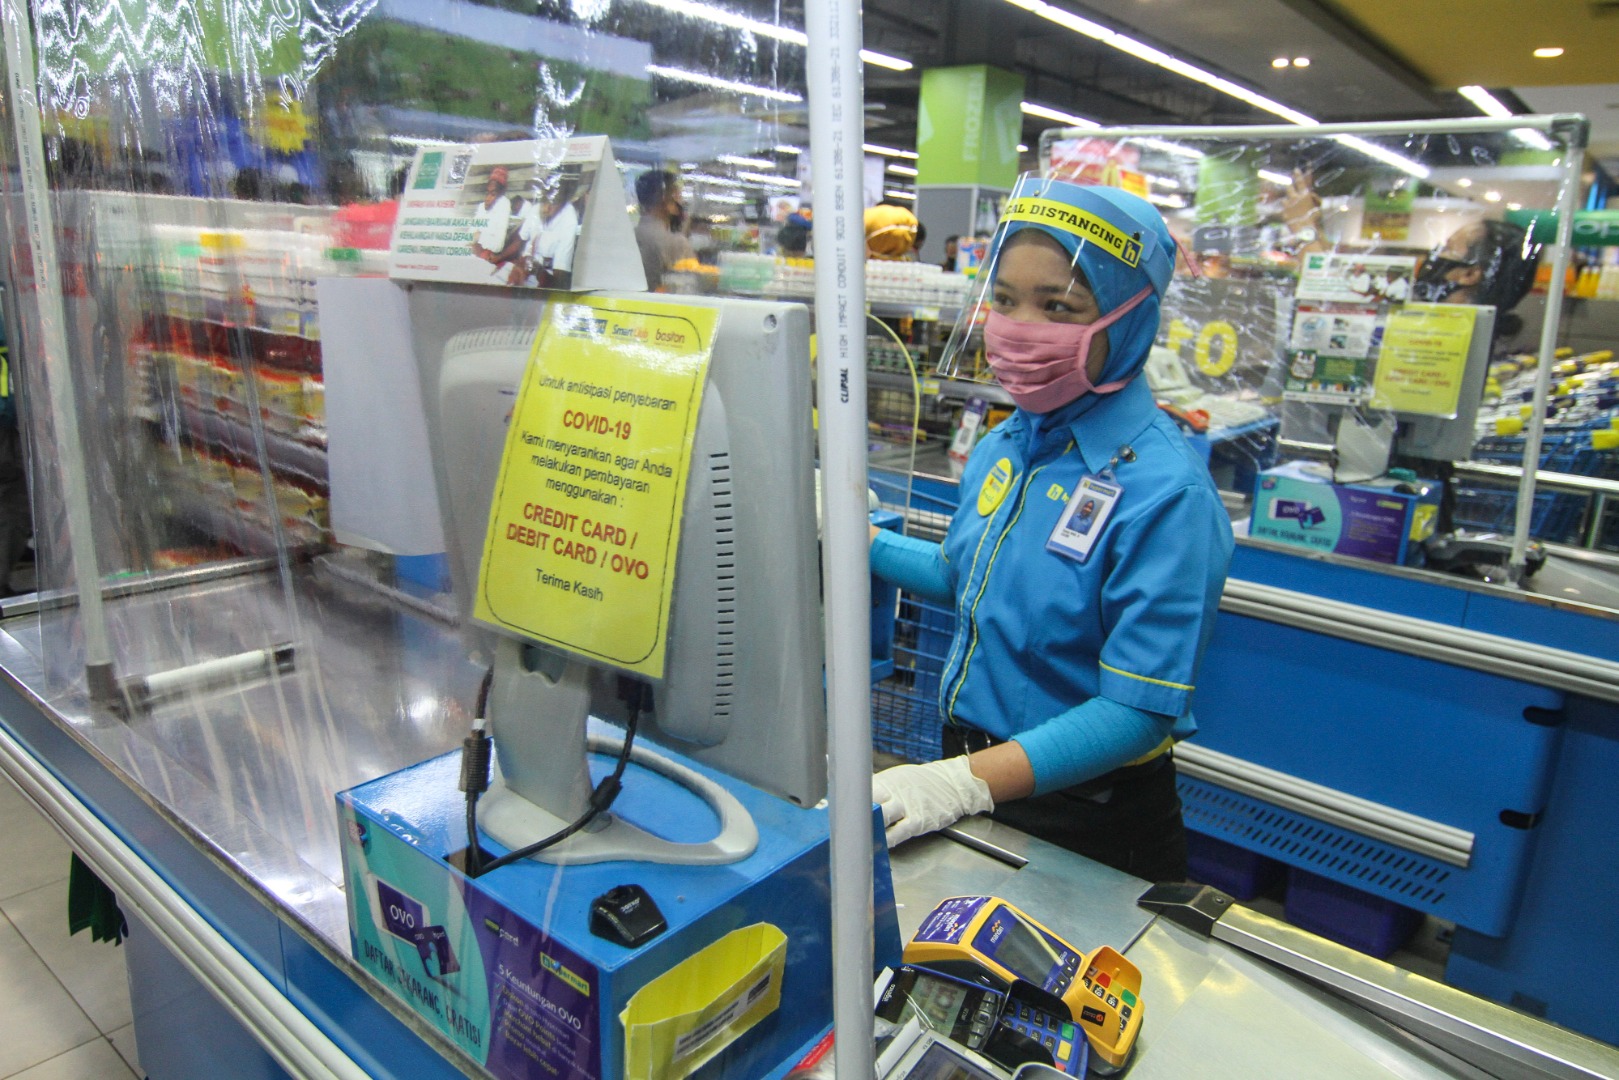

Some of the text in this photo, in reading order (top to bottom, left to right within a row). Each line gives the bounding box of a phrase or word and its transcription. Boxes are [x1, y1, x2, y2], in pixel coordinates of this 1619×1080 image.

[1029, 204, 1123, 250] DISTANCING
[837, 247, 847, 290] CONDUIT
[839, 292, 847, 329] IMPACT
[656, 328, 685, 344] boston
[539, 375, 677, 411] Untuk antisipasi penyebaran
[562, 408, 632, 441] COVID-19
[521, 430, 673, 478] Kami menyarankan agar Anda
[531, 453, 650, 494] melakukan pembayaran
[546, 476, 617, 506] menggunakan
[523, 502, 578, 532] CREDIT
[581, 519, 627, 545] CARD
[506, 522, 550, 551] DEBIT
[553, 538, 597, 566] CARD
[610, 556, 649, 580] OVO
[535, 568, 604, 602] Terima Kasih
[390, 904, 415, 928] OVO
[364, 940, 394, 978] DAFTAR
[506, 969, 557, 1013] Keuntungan
[558, 1007, 582, 1030] OVO
